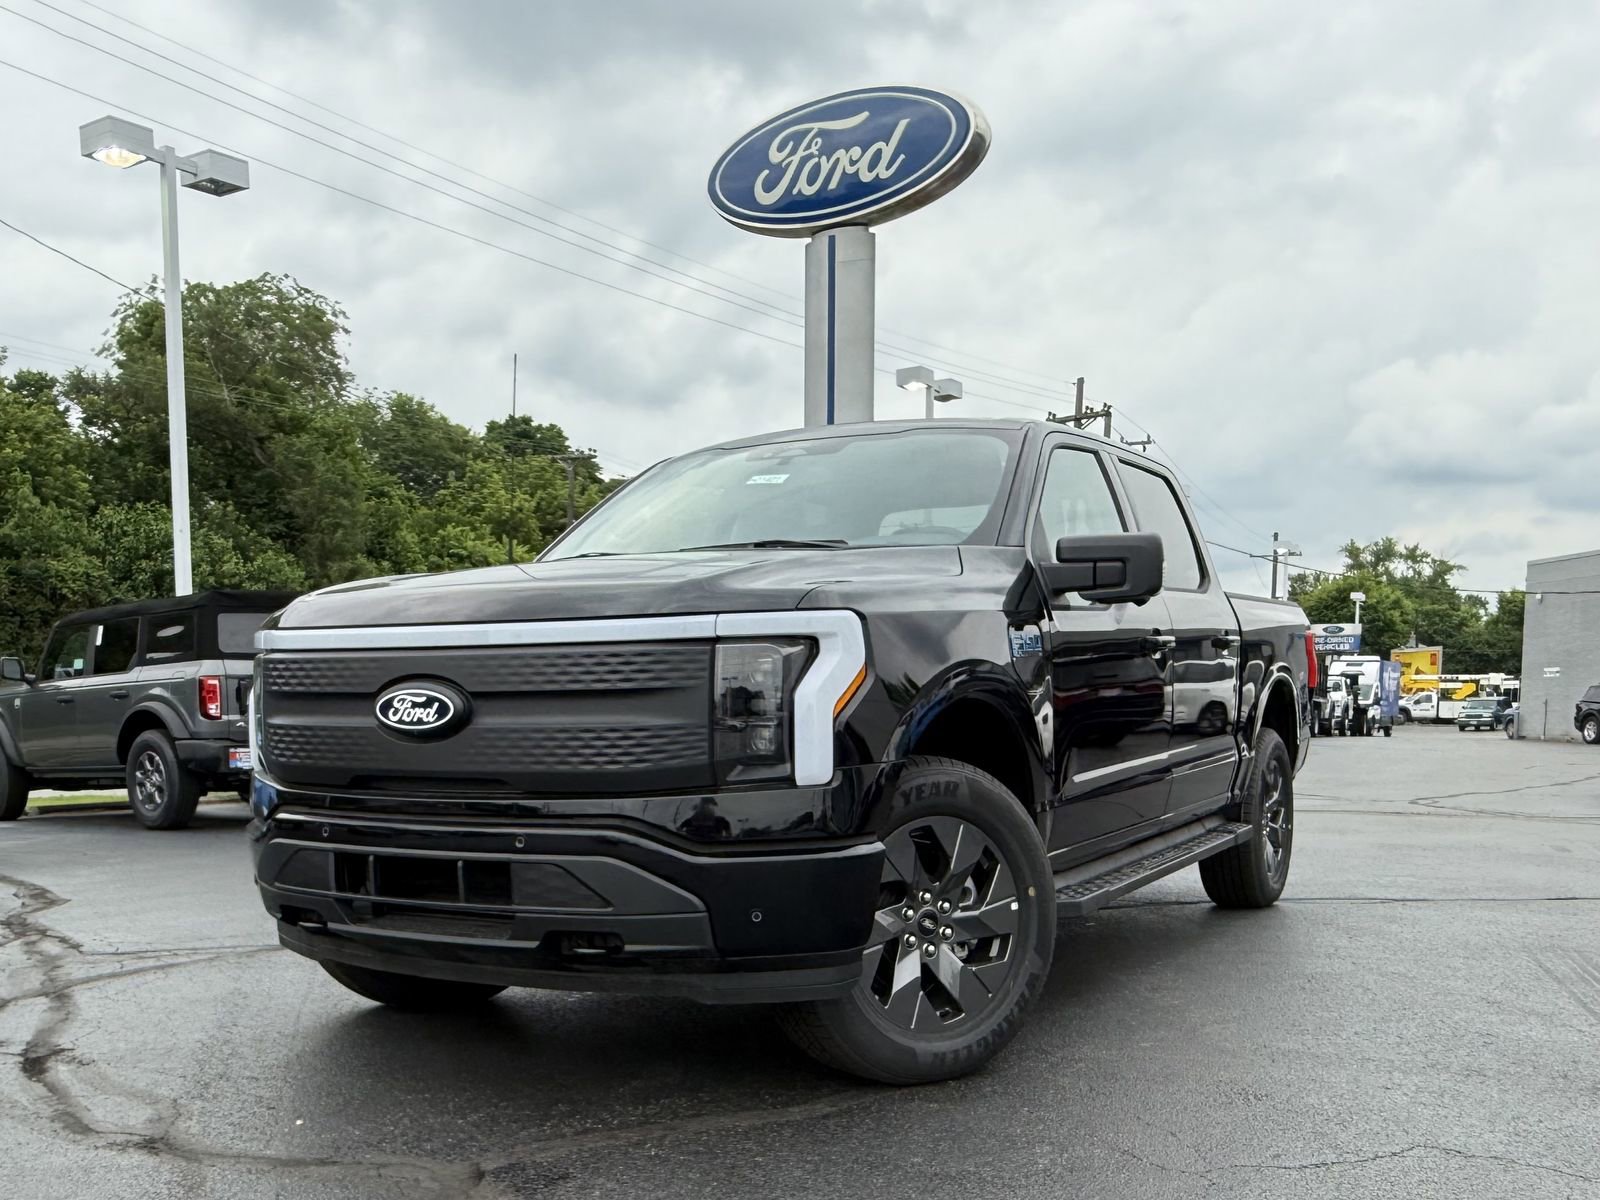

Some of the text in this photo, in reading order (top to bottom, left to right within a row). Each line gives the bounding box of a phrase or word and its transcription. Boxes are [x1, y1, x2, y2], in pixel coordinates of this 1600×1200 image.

[753, 111, 911, 206] Ford
[388, 694, 440, 722] Ford
[900, 780, 960, 807] YEAR
